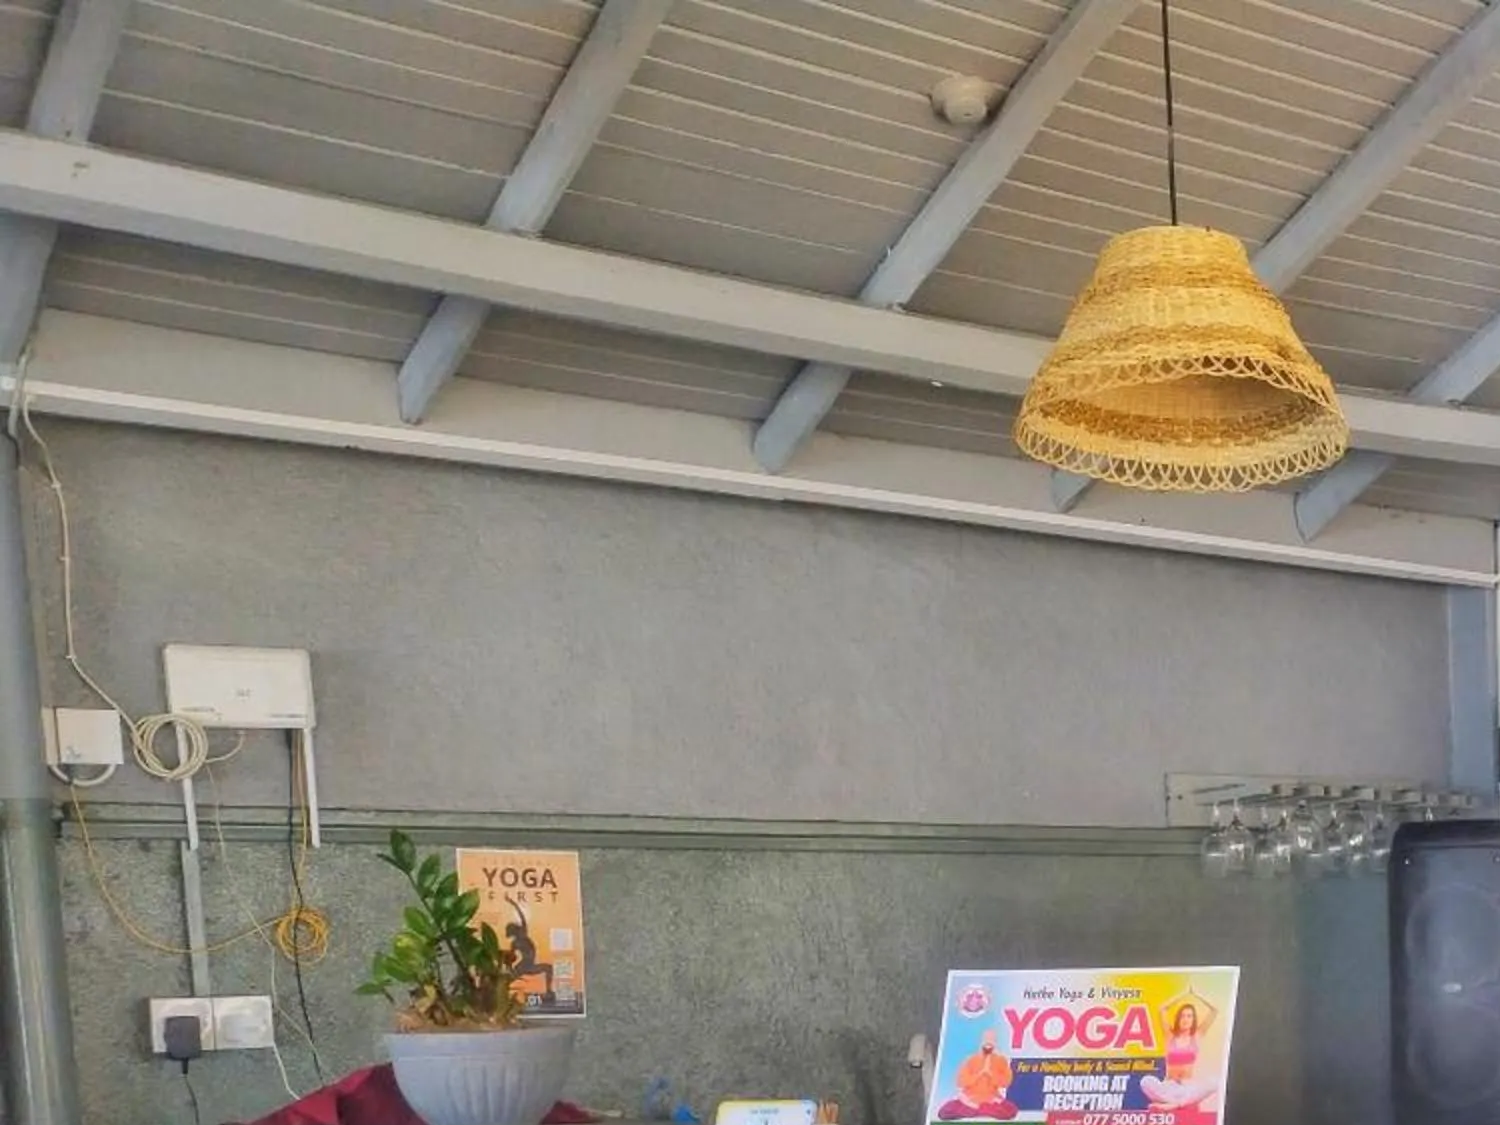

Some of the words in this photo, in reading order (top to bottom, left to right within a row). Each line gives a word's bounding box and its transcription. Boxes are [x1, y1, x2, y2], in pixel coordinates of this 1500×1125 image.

[481, 867, 558, 889] YOGA
[1059, 987, 1083, 1002] Yoga
[1087, 987, 1095, 999] &
[1004, 1006, 1155, 1050] YOGA
[1042, 1075, 1110, 1093] BOOKING
[1110, 1074, 1130, 1093] AT
[1043, 1093, 1124, 1111] RECEPTION
[1111, 1113, 1146, 1125] 5000
[1149, 1113, 1175, 1125] 530
